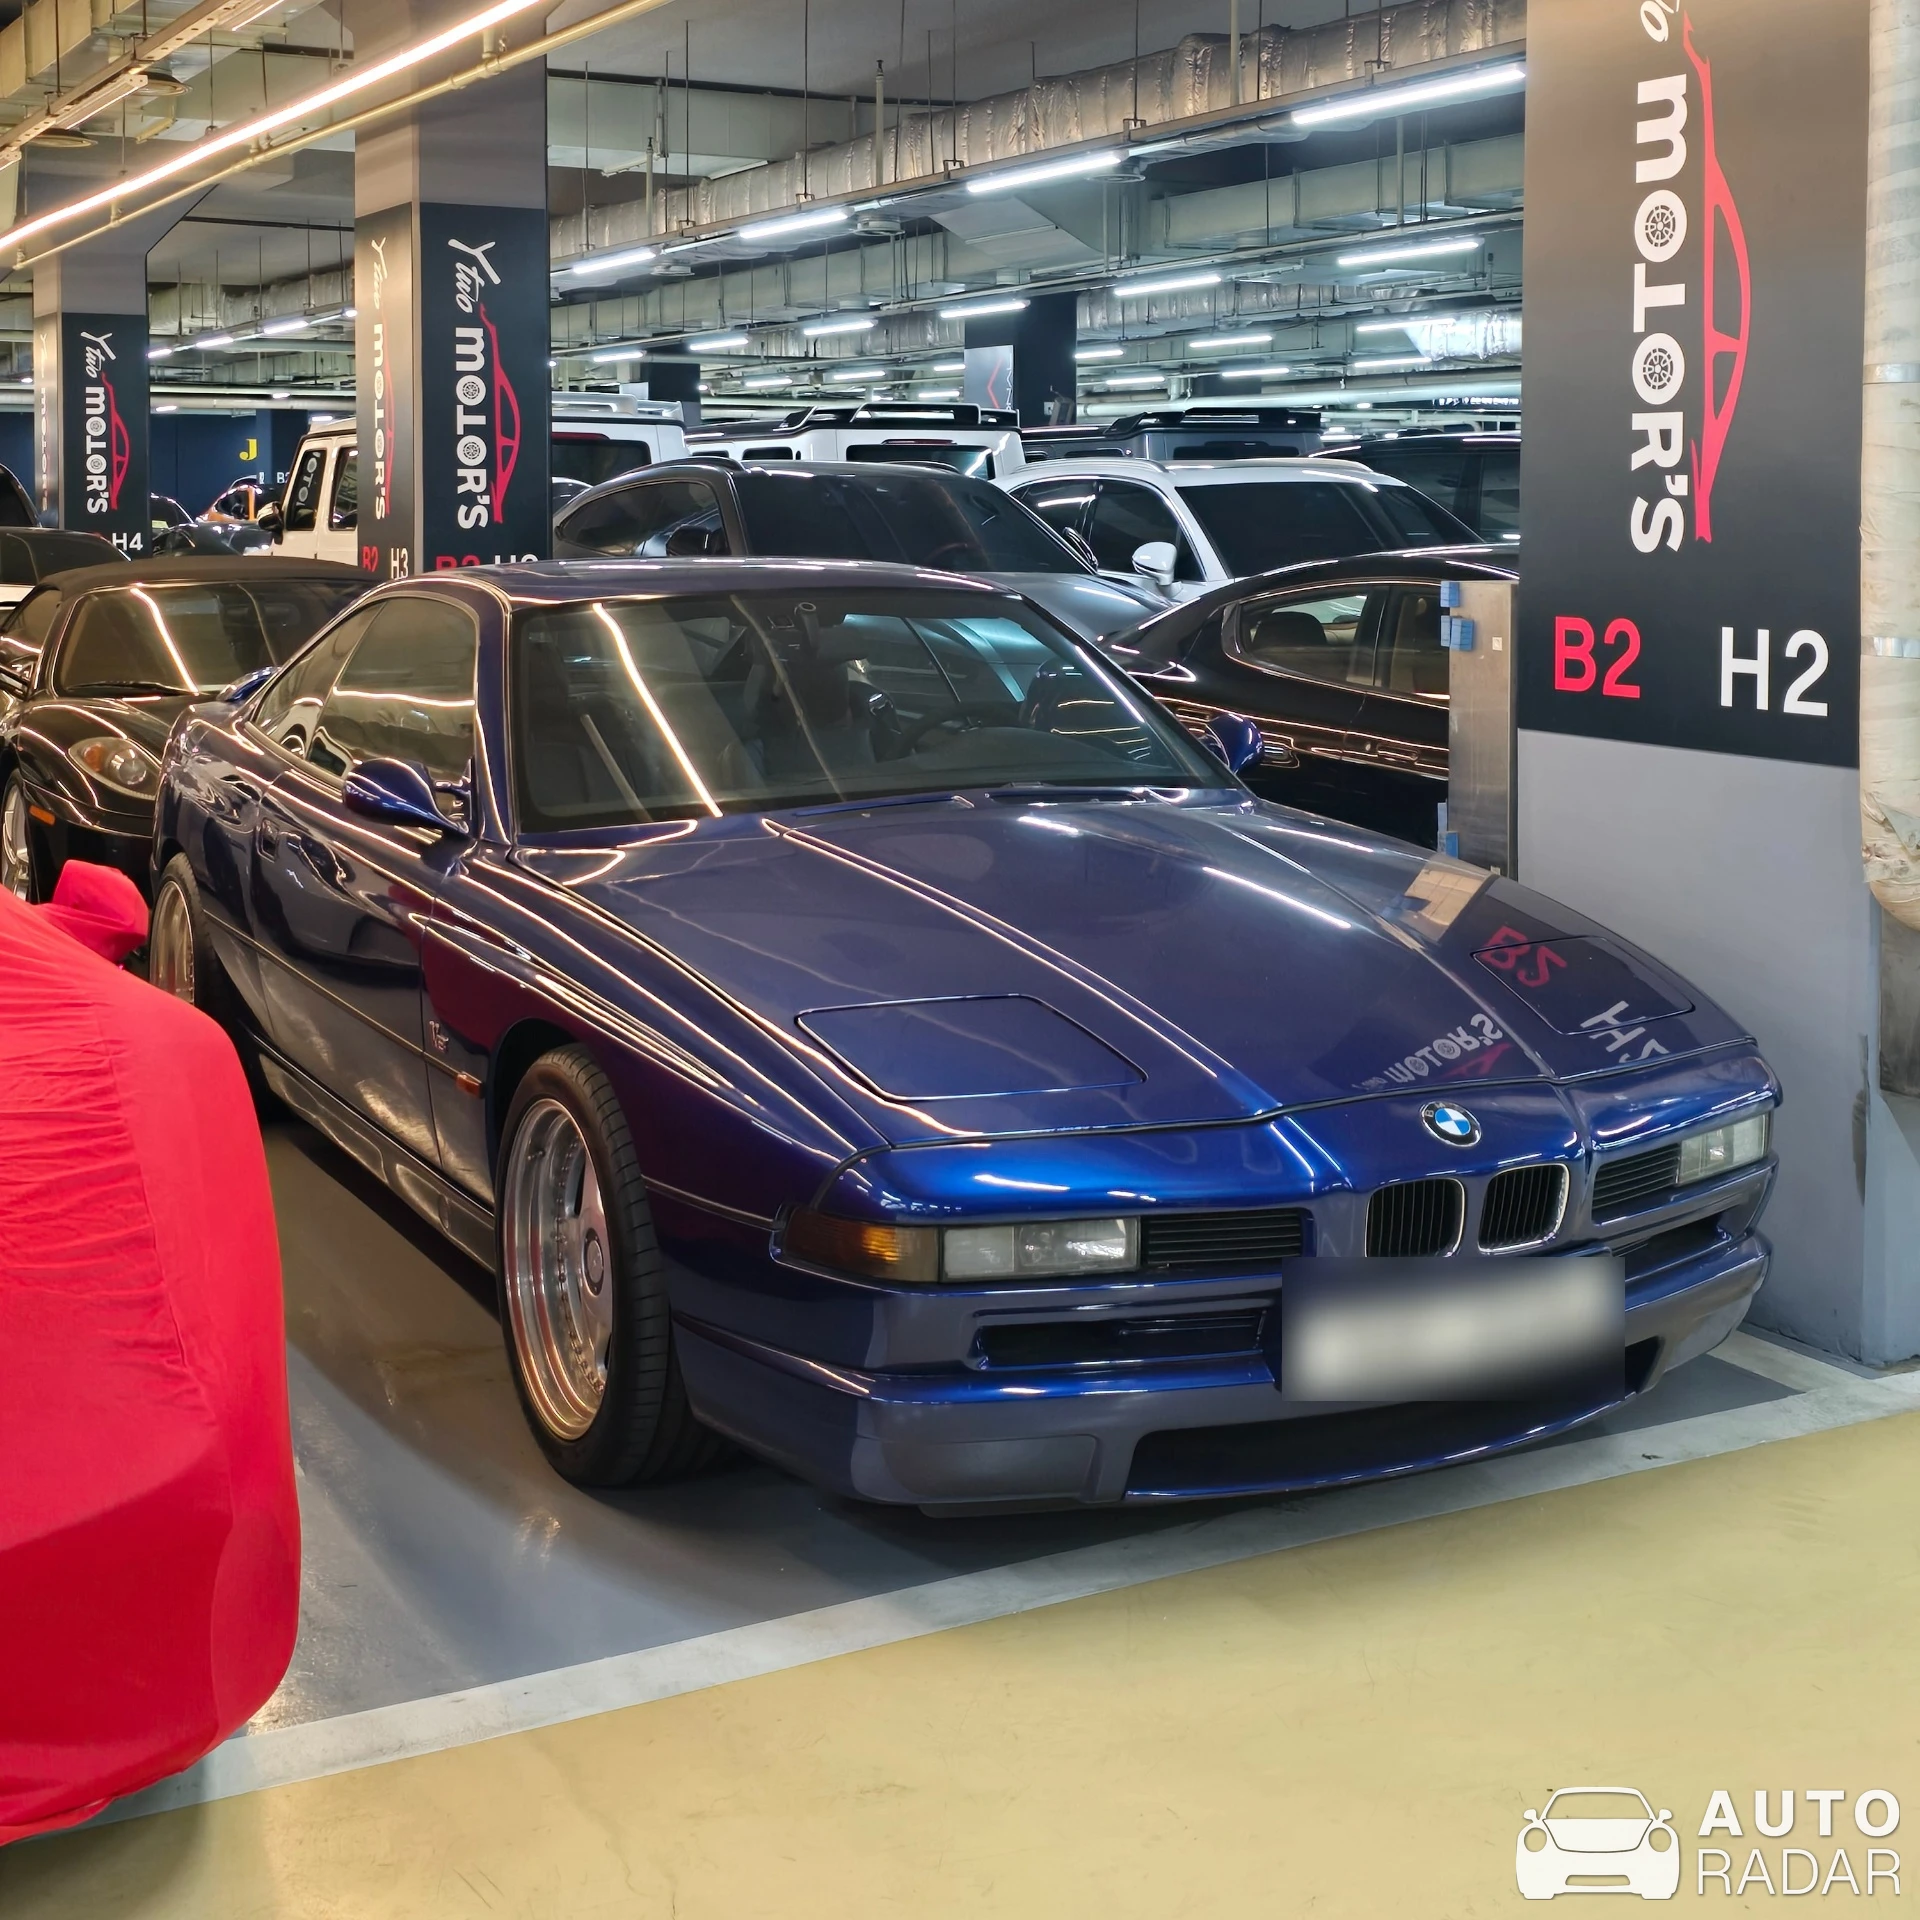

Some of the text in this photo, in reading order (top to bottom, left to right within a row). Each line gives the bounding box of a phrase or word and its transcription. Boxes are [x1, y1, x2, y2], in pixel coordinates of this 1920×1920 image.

[239, 438, 257, 461] J
[112, 532, 143, 551] H4
[391, 547, 409, 580] H3
[1554, 616, 1830, 717] B2 H2
